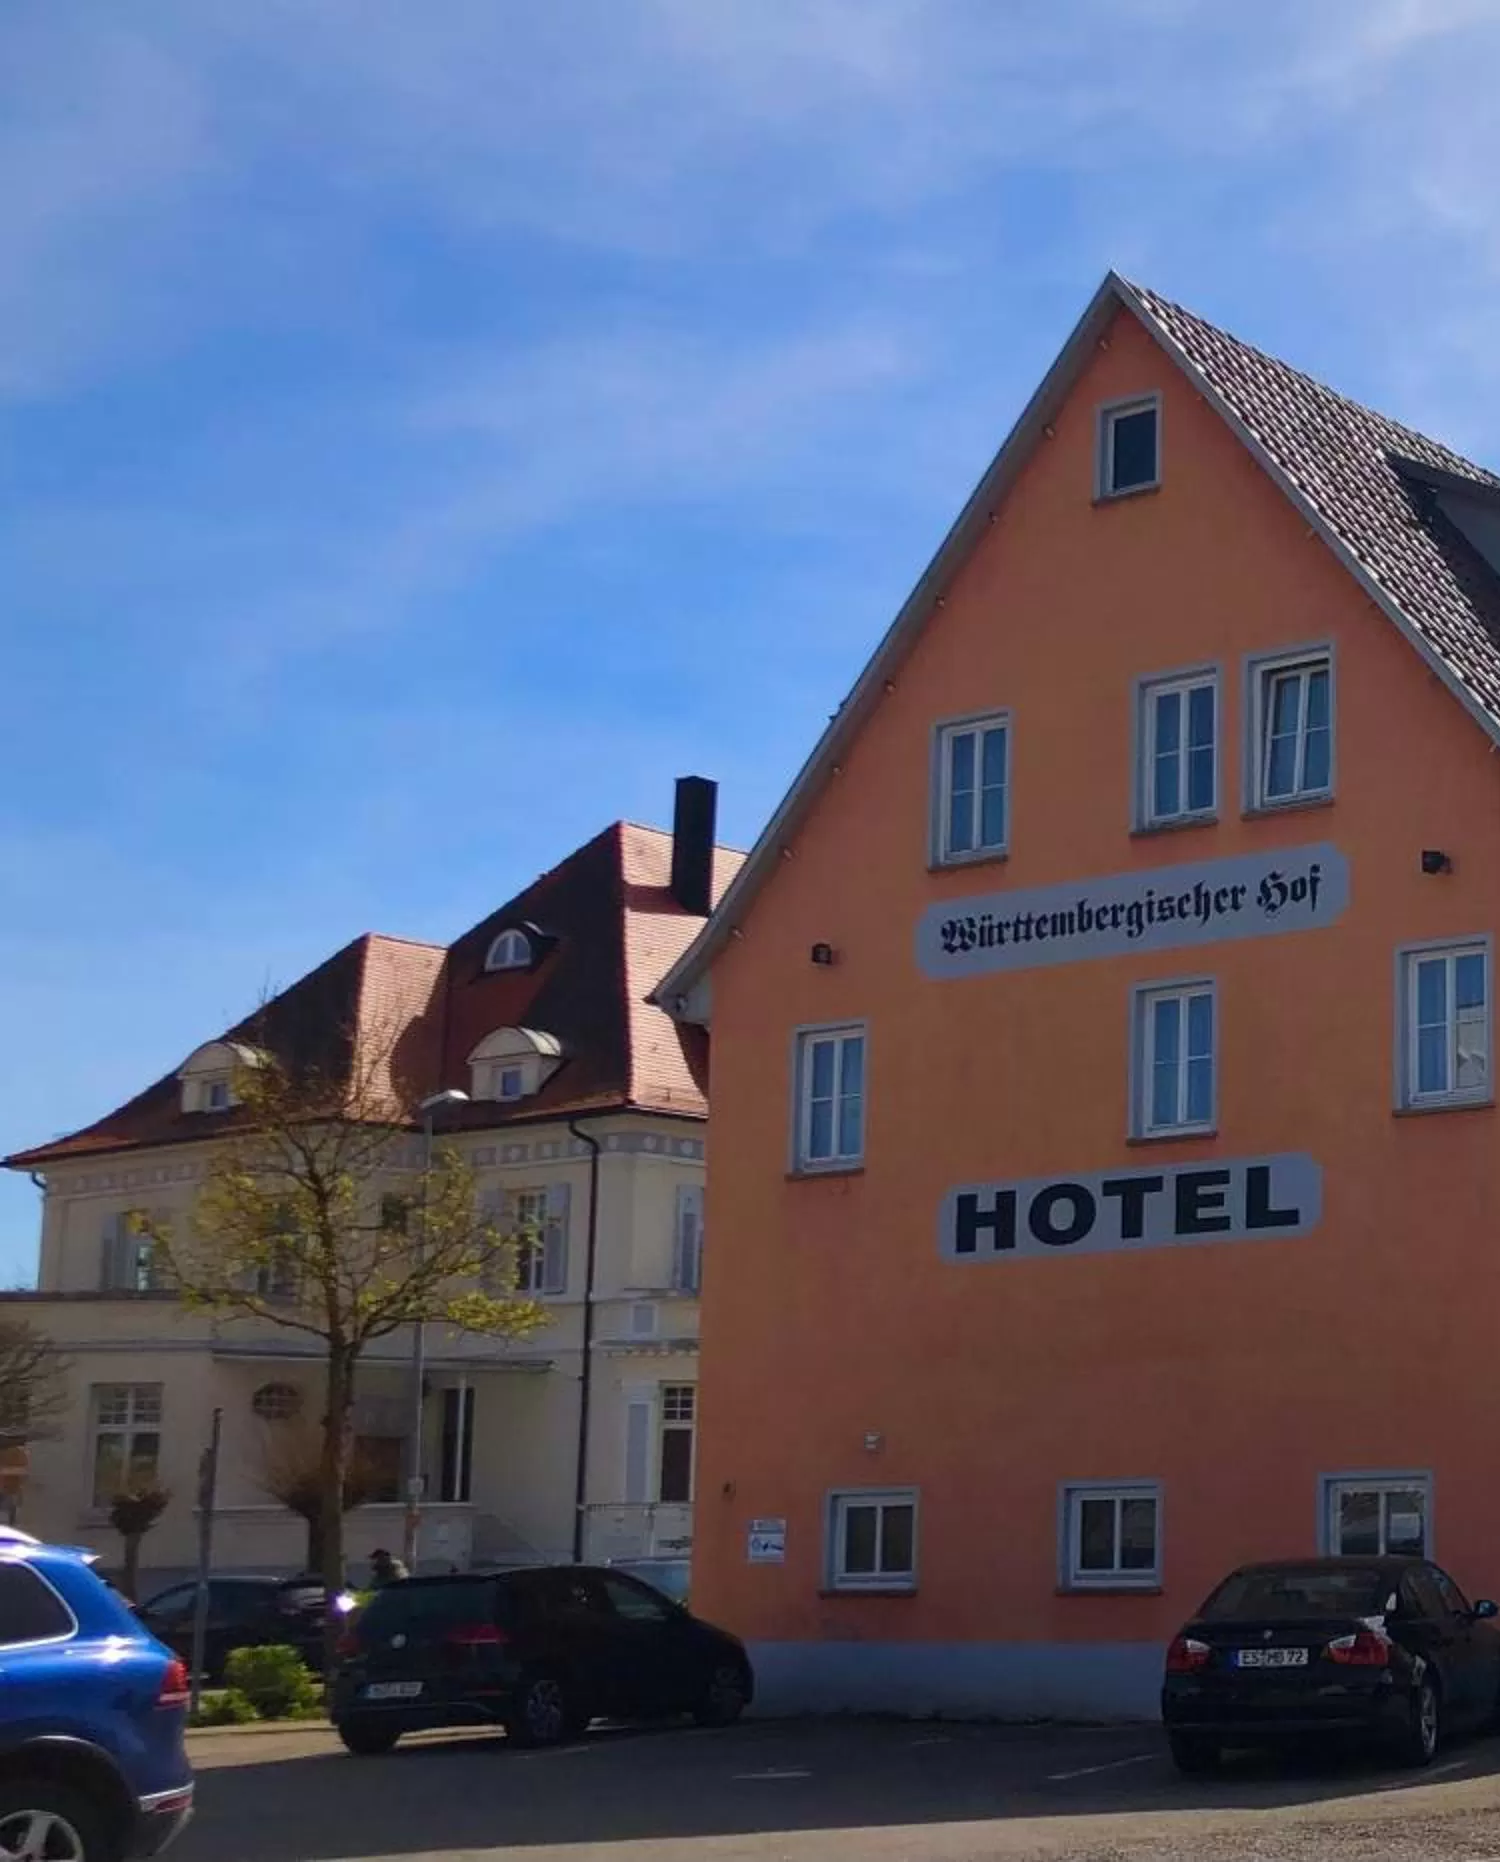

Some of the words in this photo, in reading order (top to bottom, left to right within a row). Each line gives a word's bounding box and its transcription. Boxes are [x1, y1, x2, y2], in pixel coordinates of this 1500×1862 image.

[940, 880, 1248, 954] Württembergischer
[1256, 863, 1322, 914] Hof
[955, 1166, 1299, 1253] HOTEL
